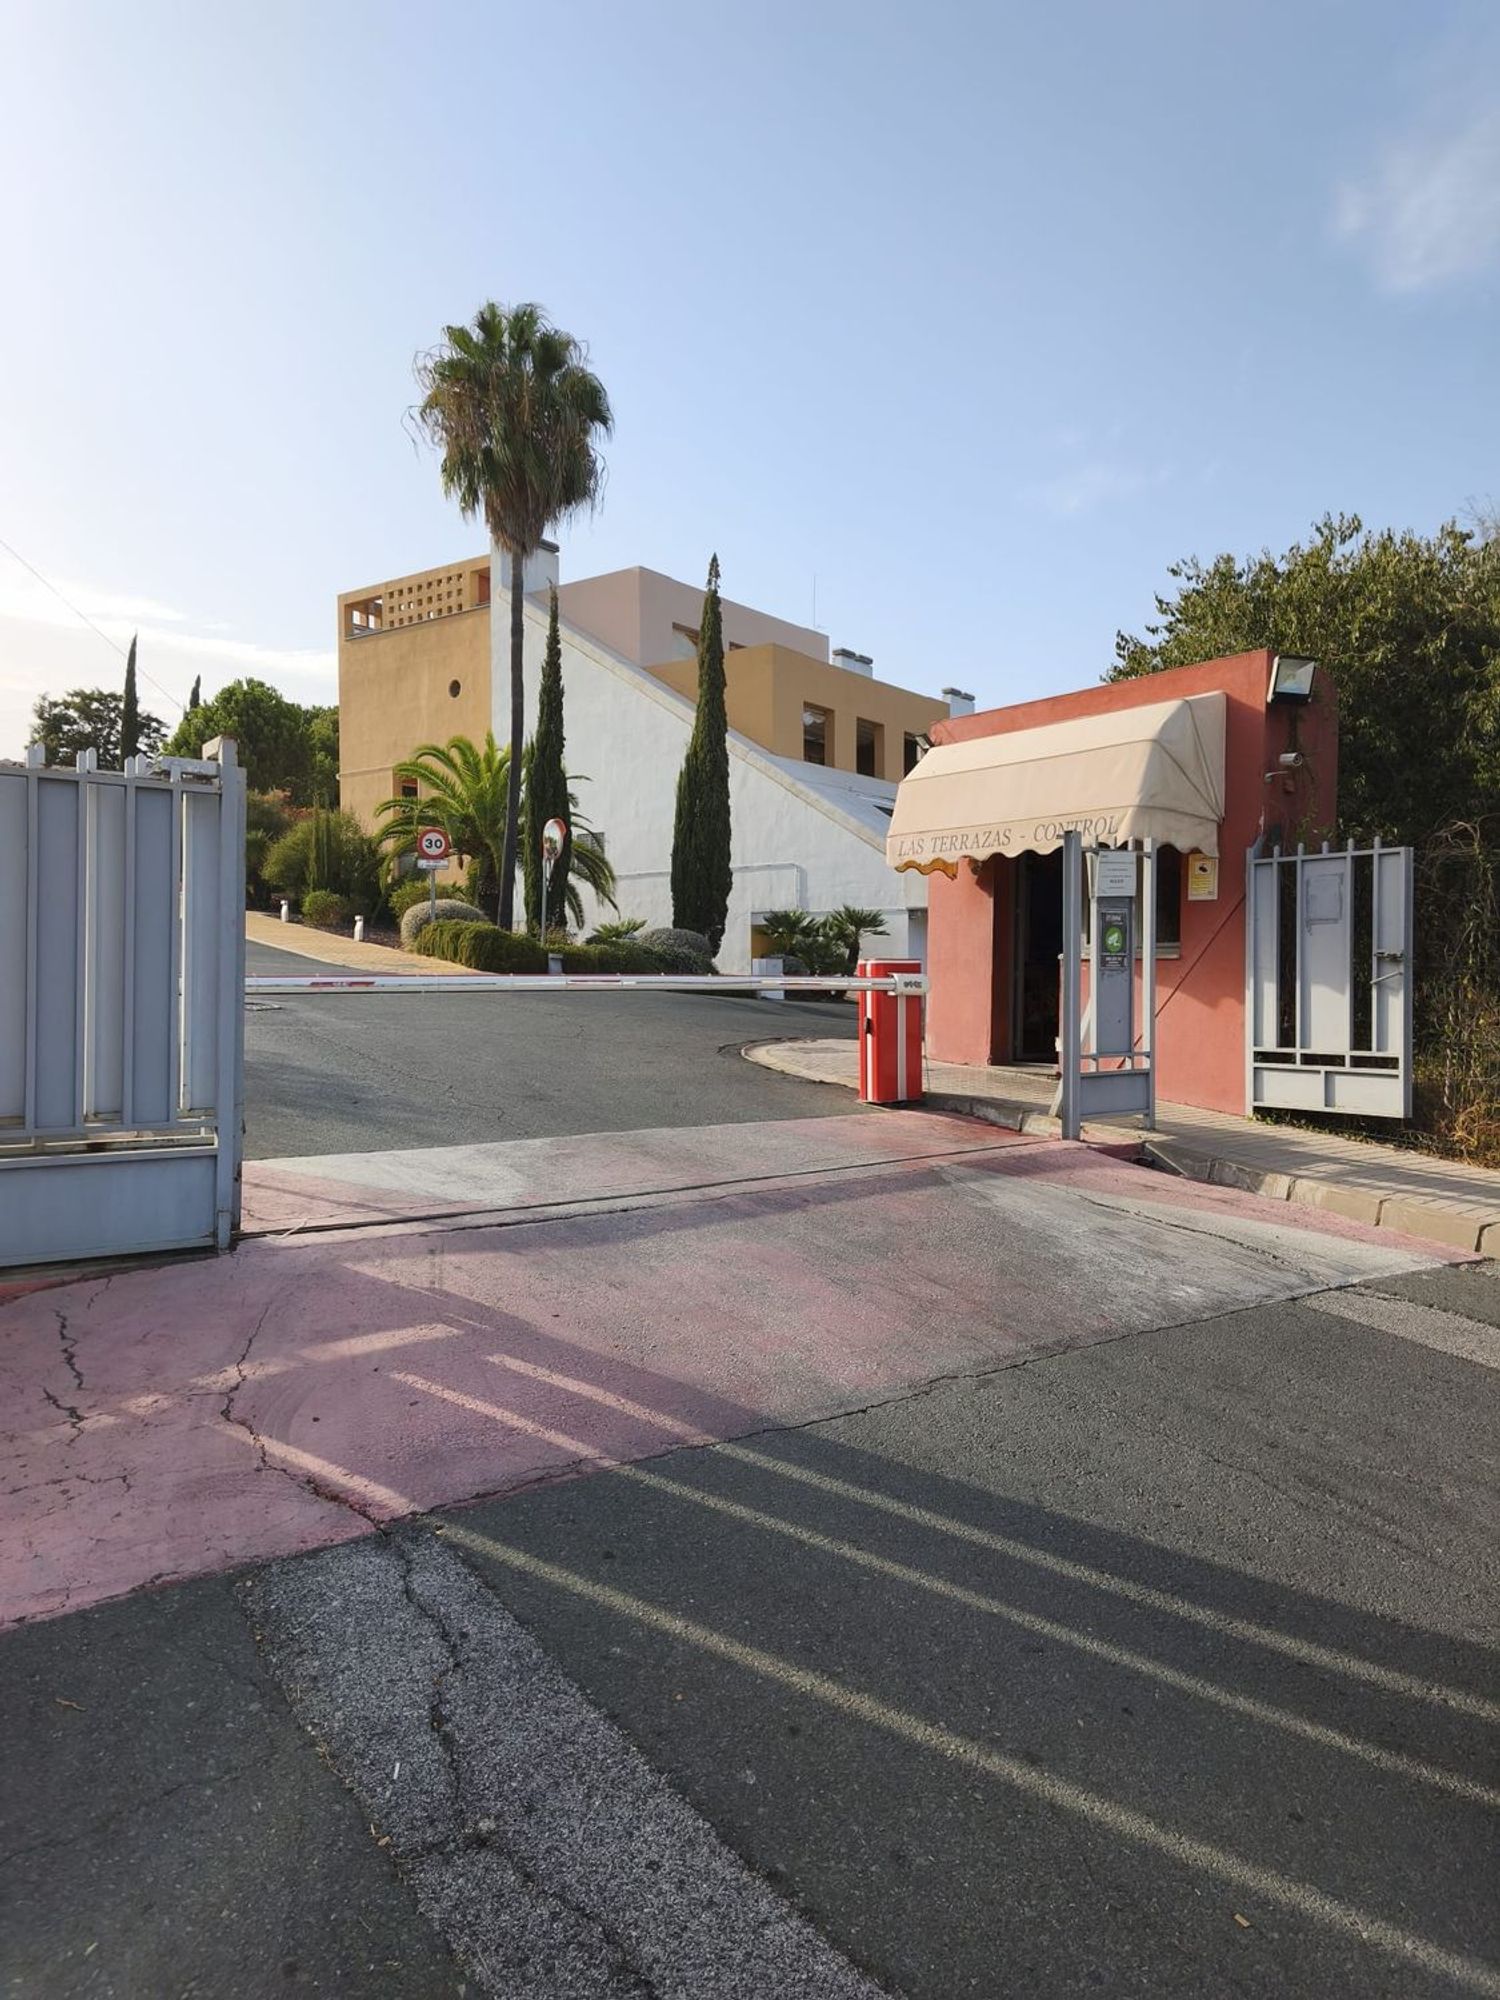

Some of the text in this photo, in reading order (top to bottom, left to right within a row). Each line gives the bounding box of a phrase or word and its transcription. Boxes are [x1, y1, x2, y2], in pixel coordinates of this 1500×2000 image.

[425, 838, 442, 849] 30
[898, 838, 924, 857] LAS
[930, 829, 1012, 854] TERRAZAS
